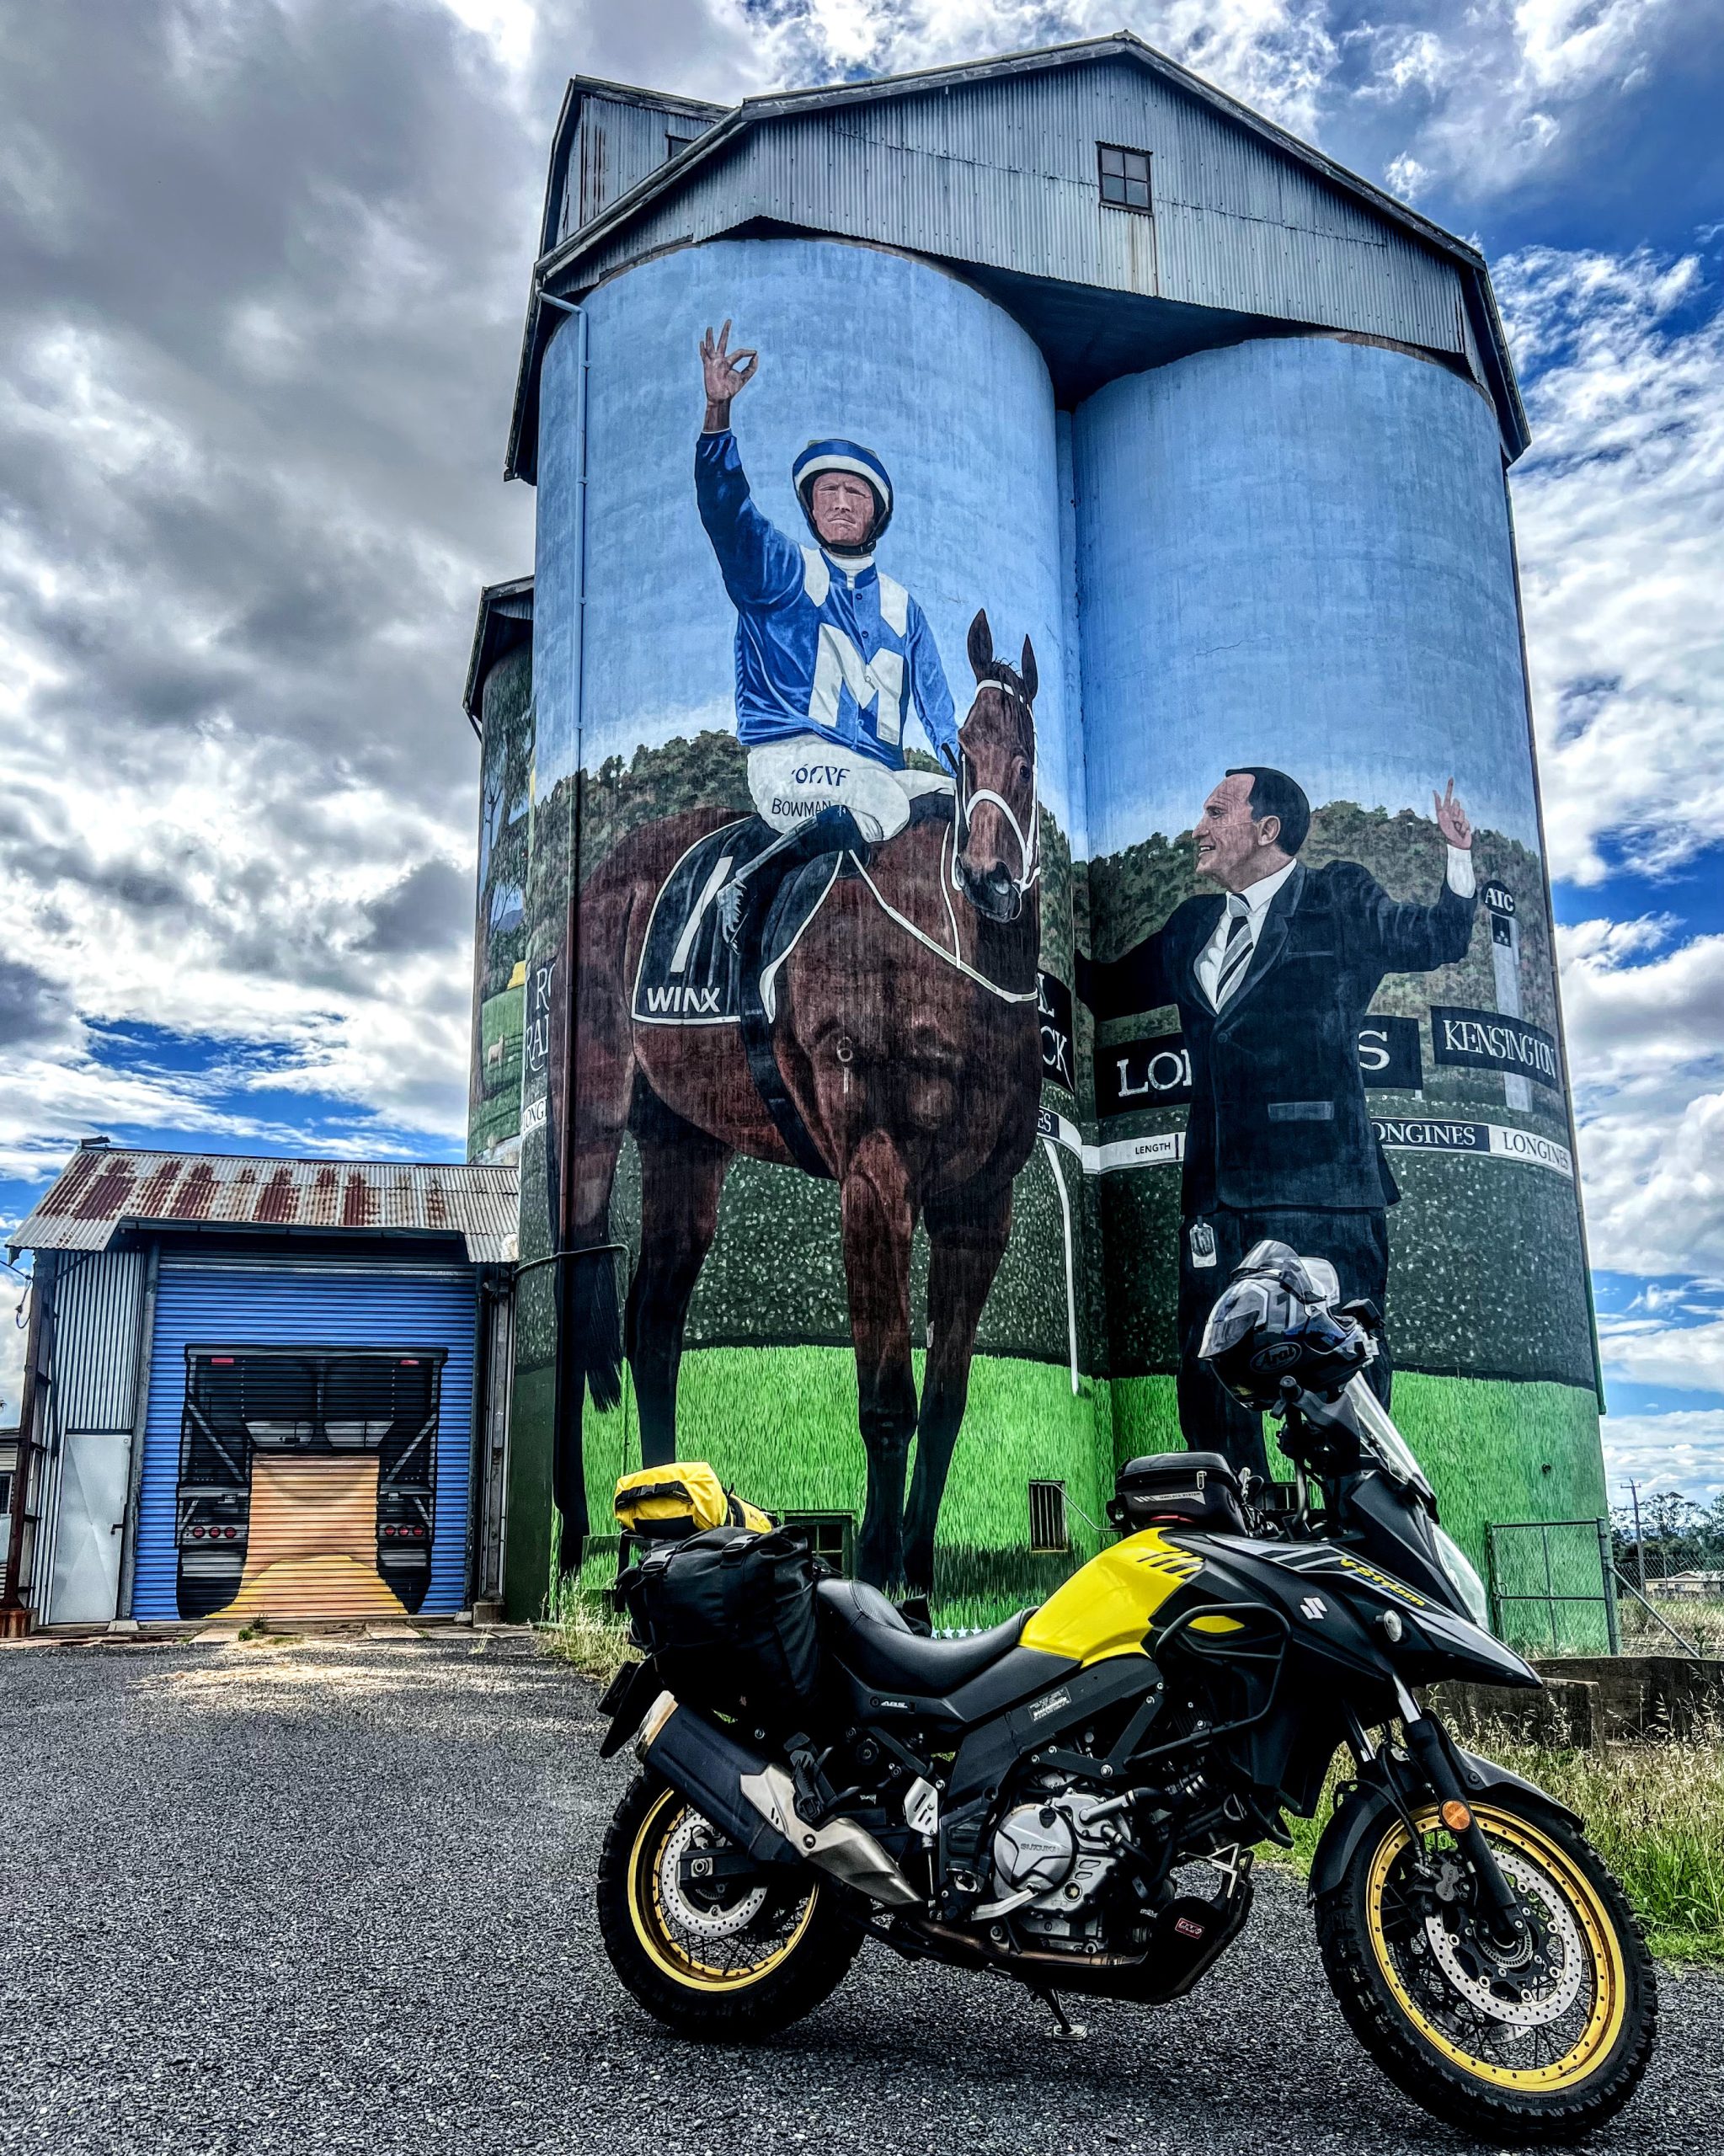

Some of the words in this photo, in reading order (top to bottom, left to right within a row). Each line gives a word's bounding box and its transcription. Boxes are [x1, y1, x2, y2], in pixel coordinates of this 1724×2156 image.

[809, 622, 905, 746] M
[1485, 888, 1514, 912] ATC
[647, 986, 721, 1013] WINX
[1443, 1020, 1556, 1079] KENSINGTON
[1135, 1142, 1171, 1155] LENGTH
[1502, 1131, 1568, 1170] LONGINES
